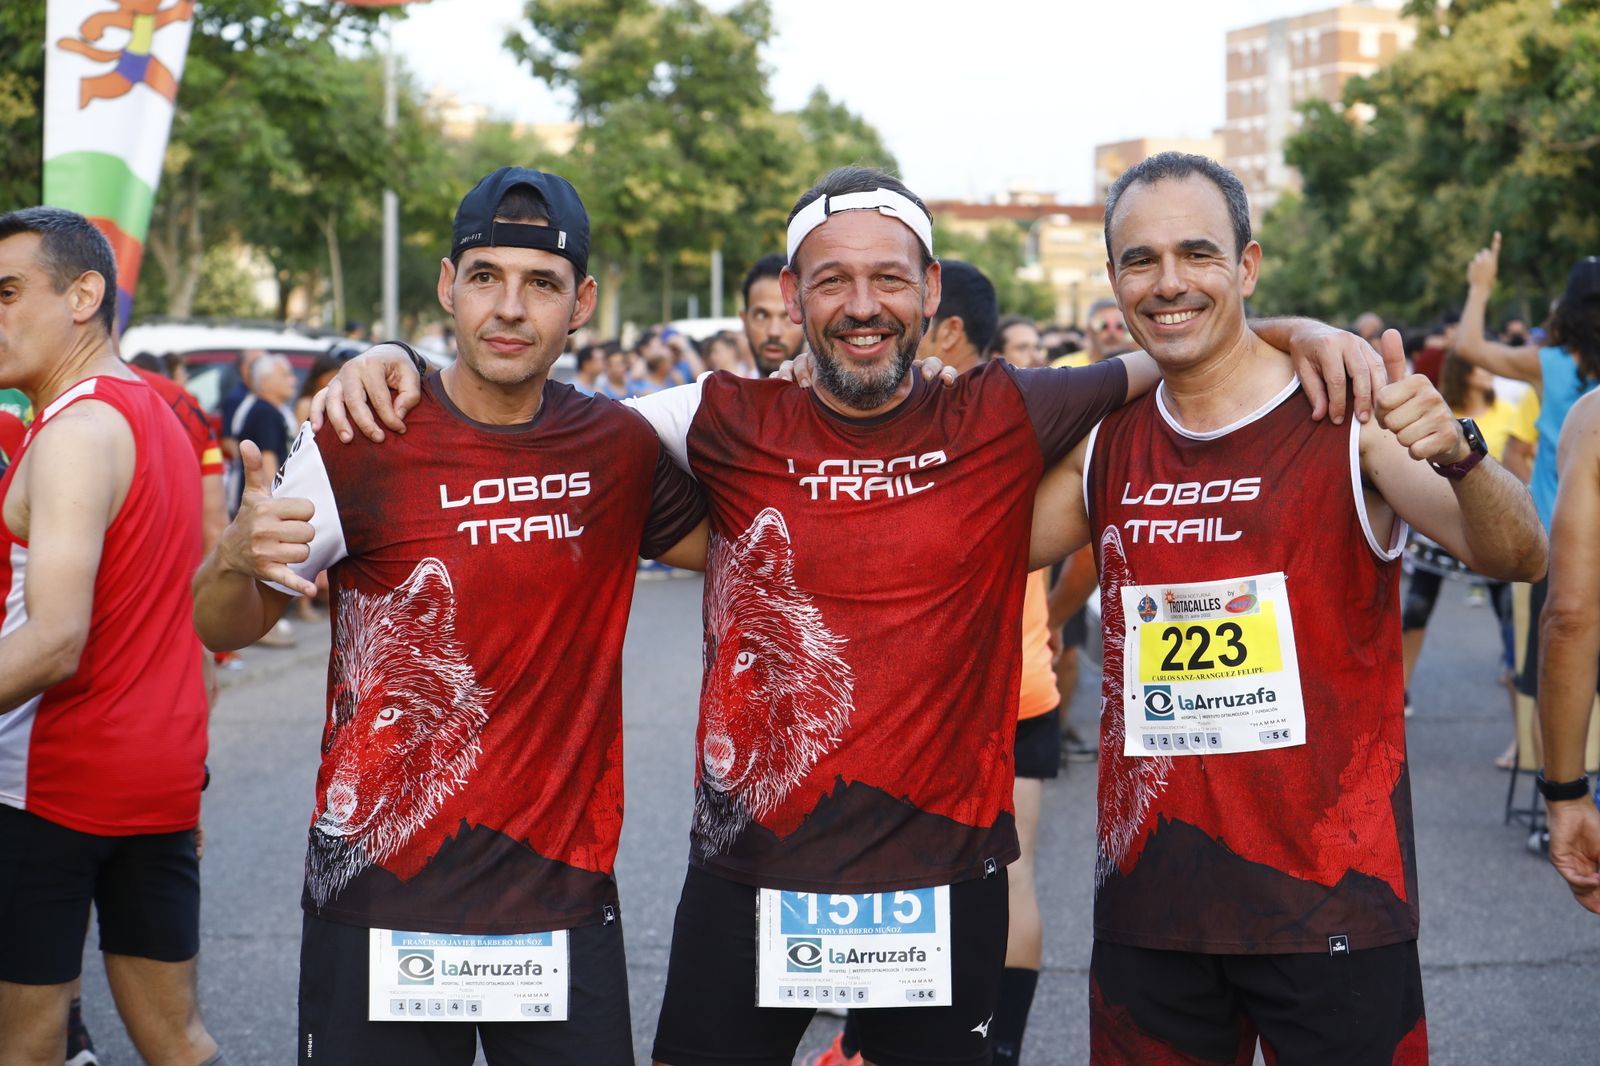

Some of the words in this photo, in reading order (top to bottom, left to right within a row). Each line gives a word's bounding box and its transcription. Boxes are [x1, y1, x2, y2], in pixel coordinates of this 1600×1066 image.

[440, 471, 591, 509] LOBOS
[799, 473, 935, 501] TRAIL
[1121, 477, 1262, 506] LOBOS
[457, 513, 584, 546] TRAIL
[1124, 517, 1243, 544] TRAIL
[1168, 598, 1221, 614] TROTACALLES
[1161, 622, 1248, 672] 223
[1176, 671, 1236, 681] SANZ-ARANGUEZ
[1237, 667, 1265, 677] FELIPE
[1177, 687, 1277, 711] laArruzafa
[1162, 737, 1168, 745] 2
[798, 891, 922, 926] 1515
[816, 927, 838, 935] TONY
[838, 927, 874, 935] BARBERO
[875, 926, 902, 934] MUÑOZ
[514, 938, 543, 946] MUÑOZ
[828, 946, 927, 964] laArruzafa
[441, 960, 543, 976] laArruzafa
[787, 989, 793, 997] 1
[803, 989, 810, 997] 2
[822, 989, 829, 997] 3
[839, 989, 846, 997] 4
[857, 991, 864, 999] 5
[398, 1002, 404, 1010] 1
[415, 1002, 421, 1010] 2
[434, 1002, 441, 1010] 3
[452, 1002, 458, 1010] 4
[471, 1004, 477, 1012] 5
